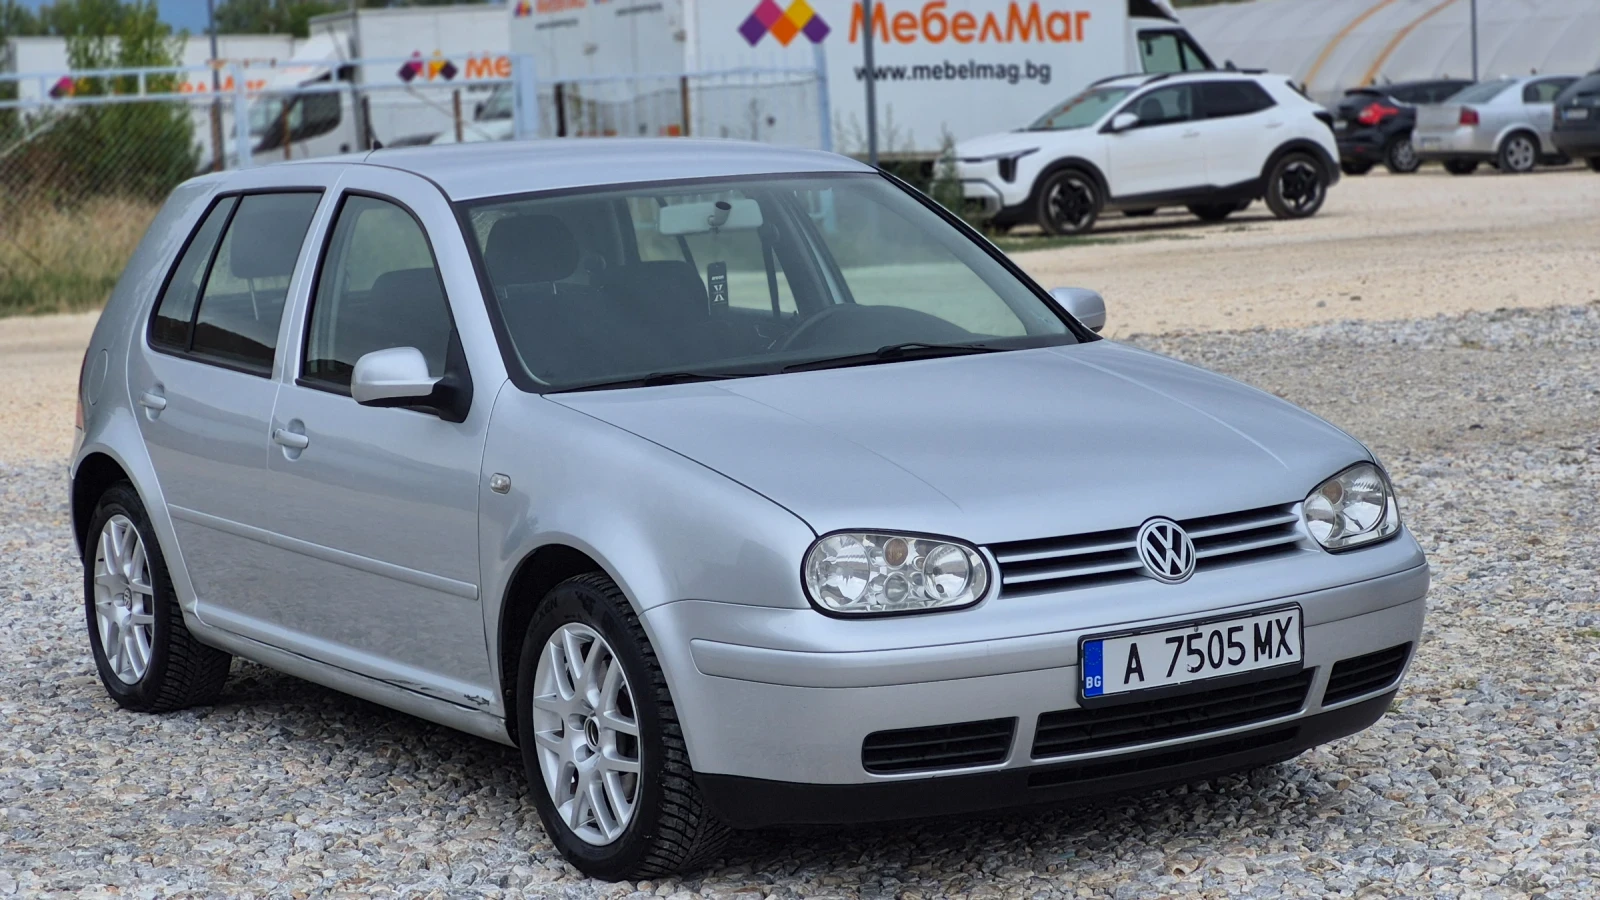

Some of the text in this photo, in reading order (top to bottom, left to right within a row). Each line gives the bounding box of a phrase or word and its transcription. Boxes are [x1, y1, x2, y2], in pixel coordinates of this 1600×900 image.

[849, 0, 1091, 44] МебелМаг
[854, 60, 1052, 84] www.mebelmag.bg
[1124, 616, 1293, 684] A 7505 MX
[1086, 675, 1101, 689] BG
